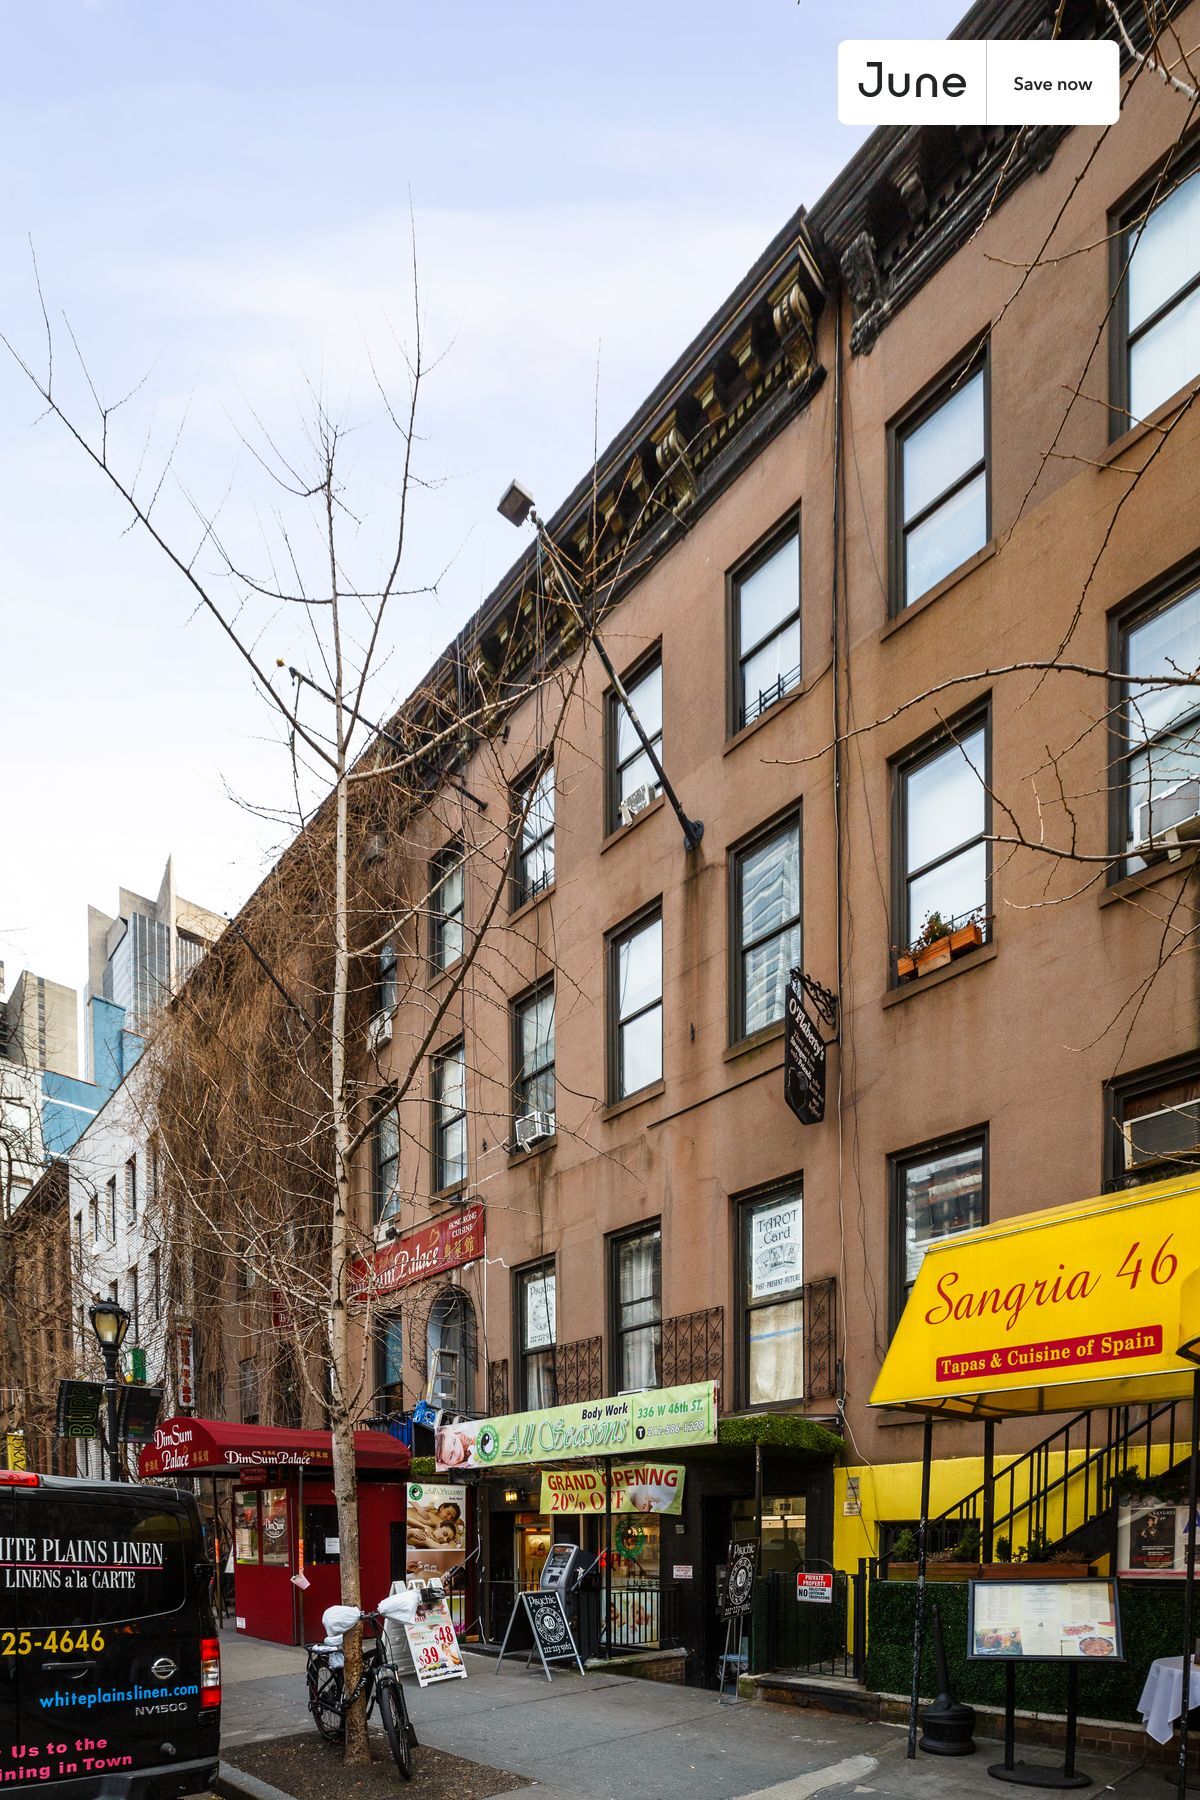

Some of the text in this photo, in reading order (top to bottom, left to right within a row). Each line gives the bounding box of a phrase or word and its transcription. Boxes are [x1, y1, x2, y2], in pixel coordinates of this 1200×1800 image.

[757, 1208, 799, 1232] TAROT
[763, 1226, 791, 1245] Card
[395, 1244, 439, 1280] Palace
[530, 1282, 556, 1298] Psyhic
[924, 1233, 1178, 1332] Sangria 46
[941, 1332, 1156, 1376] Tapas & Cuisine of Spain
[582, 1402, 629, 1421] Body Work
[637, 1406, 654, 1419] 336
[657, 1405, 666, 1416] W
[668, 1402, 688, 1414] 46th
[501, 1421, 536, 1456] All
[538, 1418, 630, 1452] Seasons
[161, 1449, 190, 1471] Palace
[547, 1473, 597, 1491] GRAND
[551, 1489, 626, 1511] 20% OF
[42, 1539, 108, 1564] PLAINS
[113, 1541, 164, 1565] LINEN
[5, 1569, 61, 1588] LINENS
[92, 1570, 136, 1589] CARTE
[527, 1595, 556, 1608] Psychic
[798, 1589, 808, 1597] NO
[1, 1629, 105, 1656] 25-4646
[434, 1625, 454, 1645] $48
[419, 1646, 439, 1666] $39
[40, 1684, 199, 1709] whiteplainslinen.com
[135, 1702, 189, 1716] NV1500
[11, 1738, 108, 1758] Us to the
[59, 1761, 77, 1774] in
[83, 1755, 133, 1771] Town
